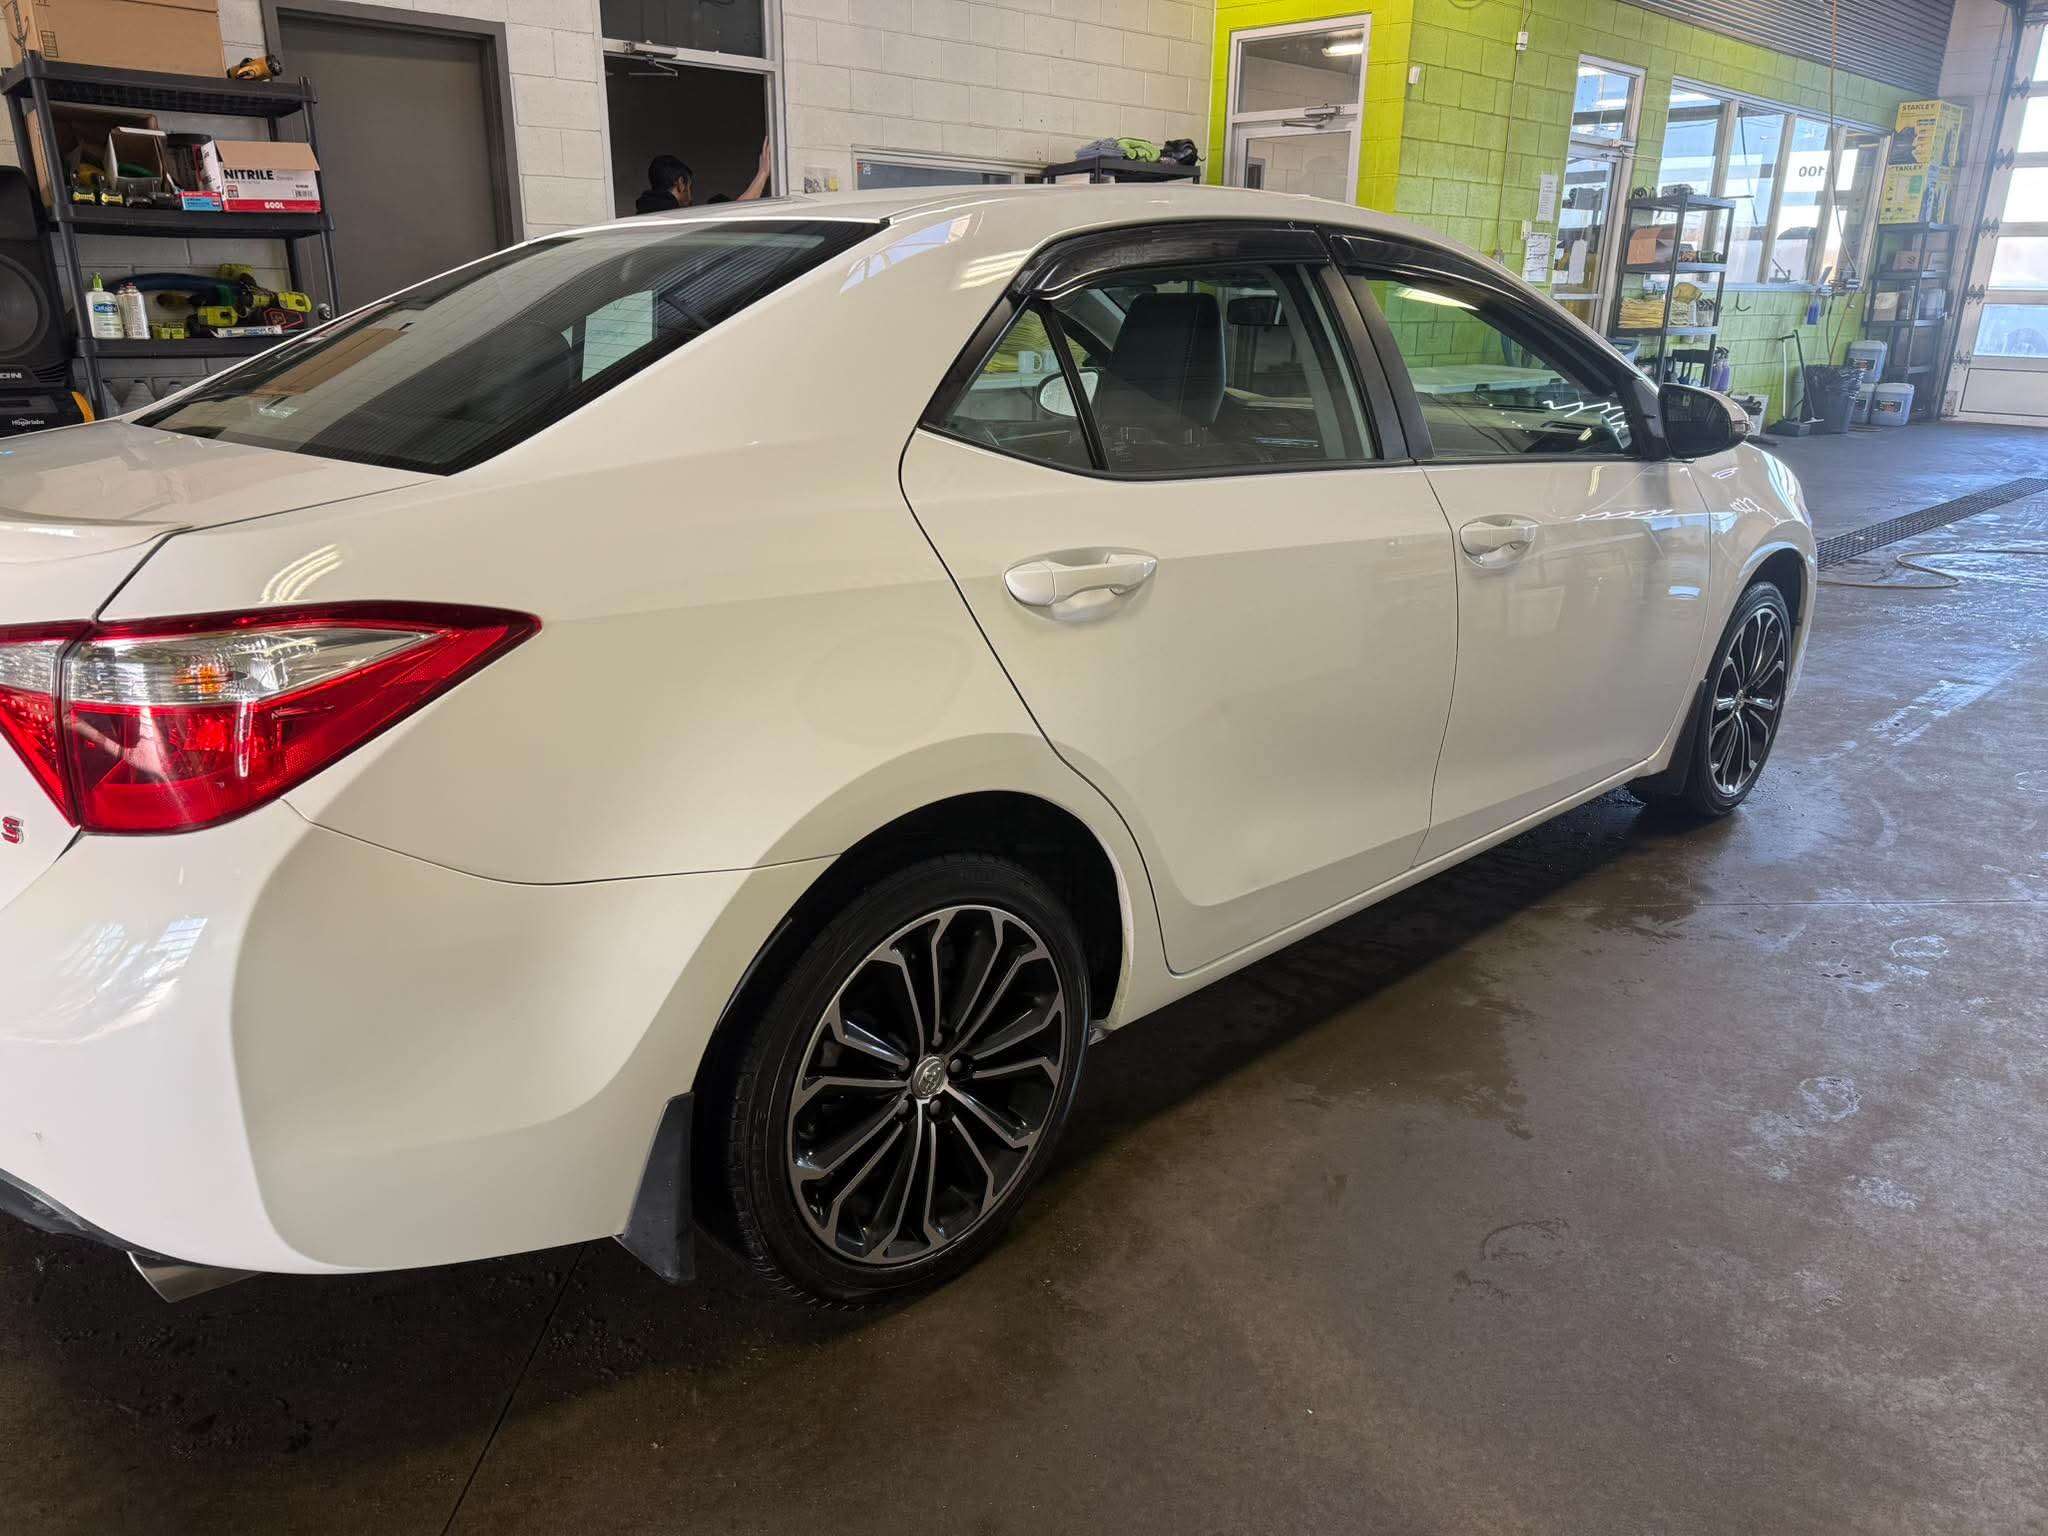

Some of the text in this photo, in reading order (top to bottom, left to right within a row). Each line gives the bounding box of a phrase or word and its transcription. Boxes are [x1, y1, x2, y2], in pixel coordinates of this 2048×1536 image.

[1901, 103, 1936, 112] STANLEY
[223, 168, 275, 180] NITRILE
[1, 816, 24, 845] S
